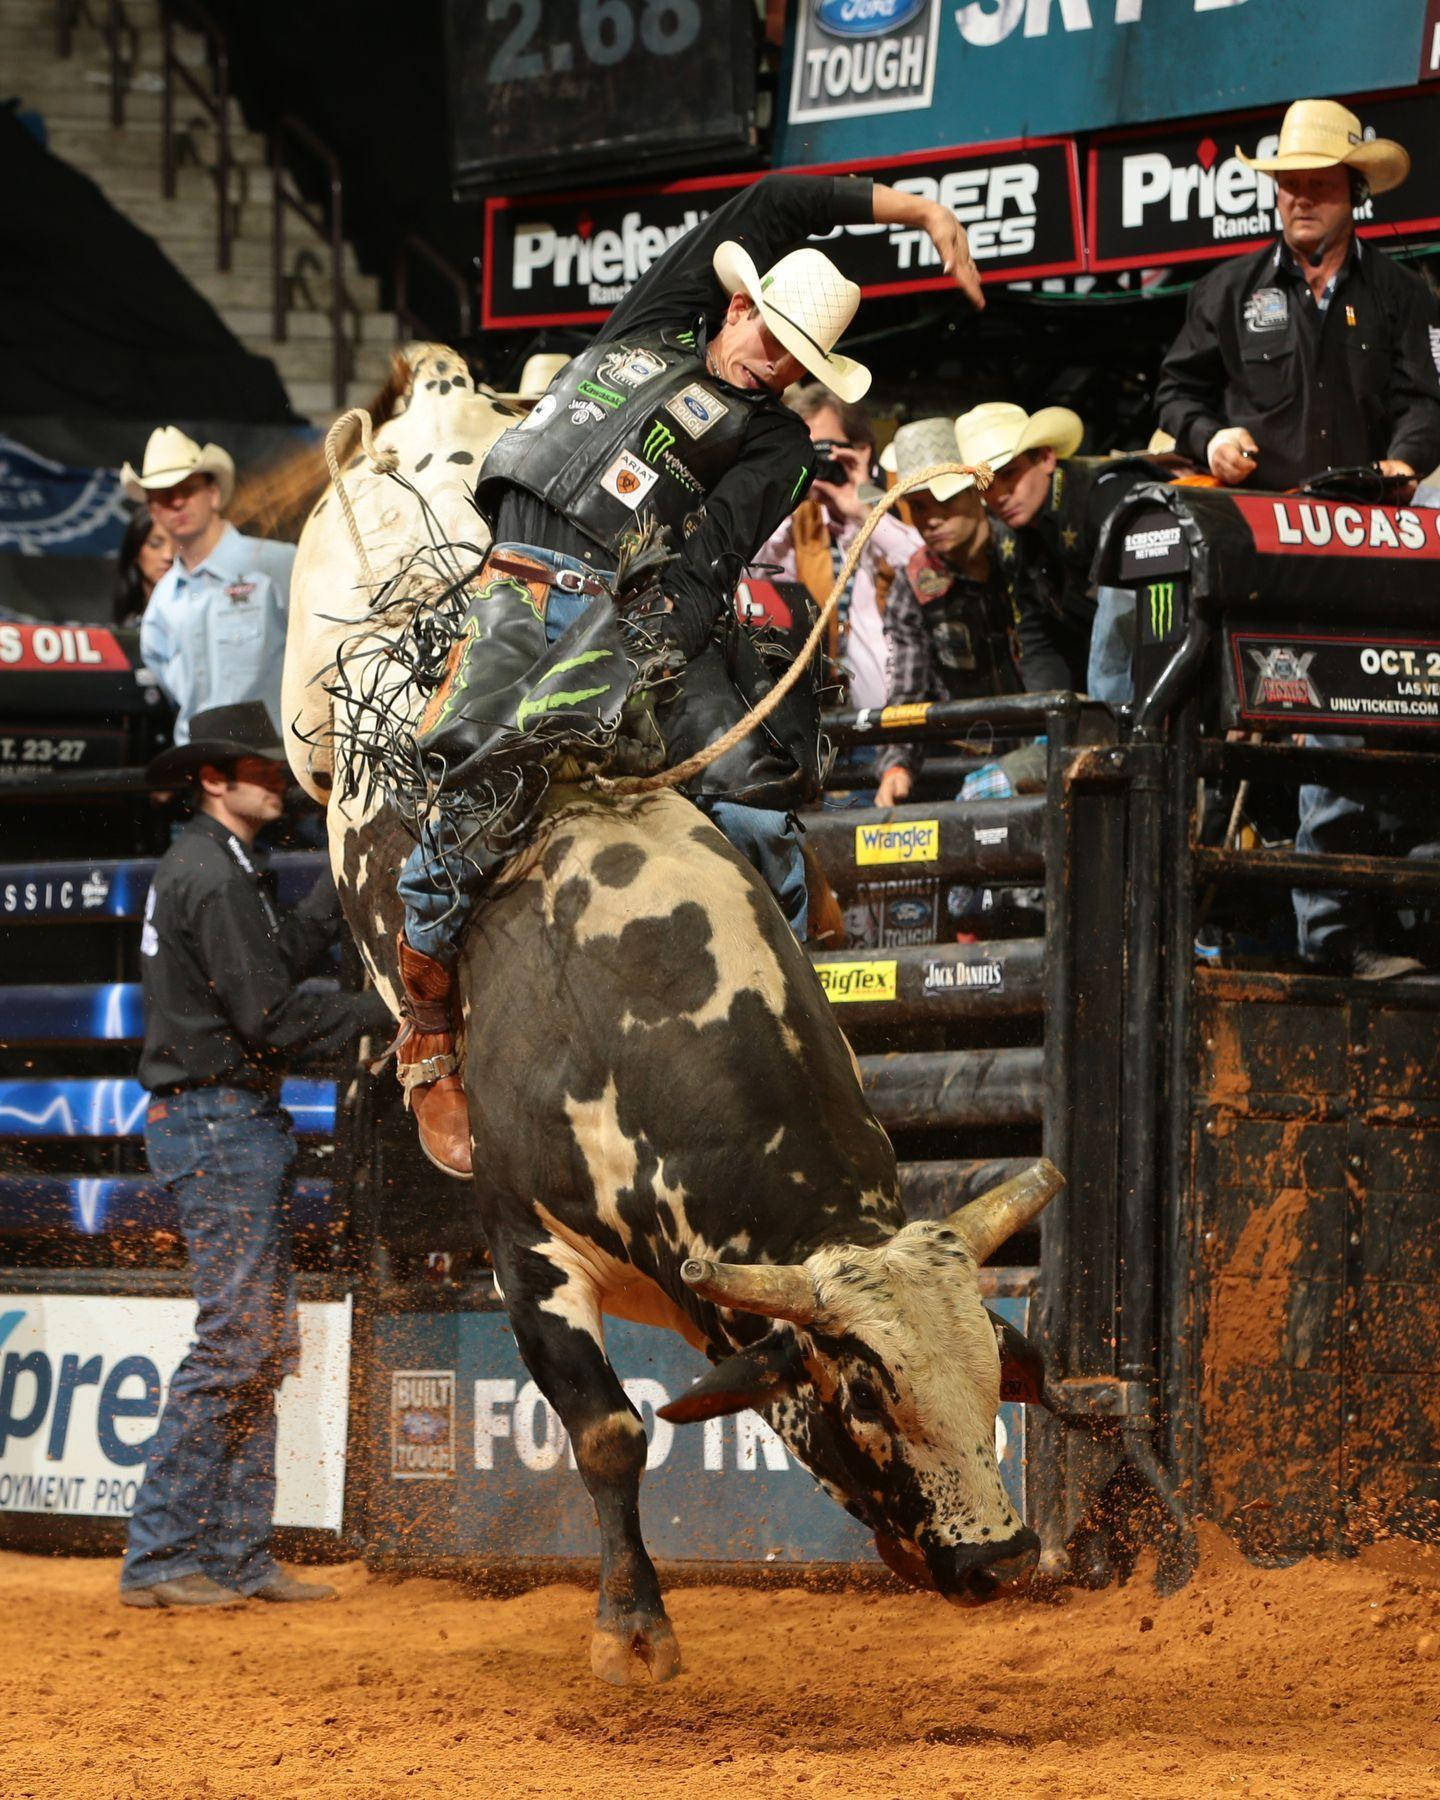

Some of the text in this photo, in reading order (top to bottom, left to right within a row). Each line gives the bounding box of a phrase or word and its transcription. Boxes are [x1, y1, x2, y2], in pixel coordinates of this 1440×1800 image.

[806, 35, 926, 100] TOUGH
[1212, 208, 1271, 240] Ranch
[889, 216, 1037, 270] TIES
[689, 386, 721, 415] BUILT
[621, 455, 655, 482] ARIAT
[1272, 502, 1427, 551] LUCAS
[32, 627, 103, 664] OIL
[1360, 648, 1421, 676] OCT.
[1397, 681, 1422, 696] LAS
[1330, 697, 1440, 716] UNLVTICKETS.COM
[21, 738, 87, 762] 23-27
[862, 825, 934, 858] Wrangler
[924, 962, 956, 988] JACK
[398, 1378, 451, 1409] BUILT
[473, 1378, 676, 1471] FOD
